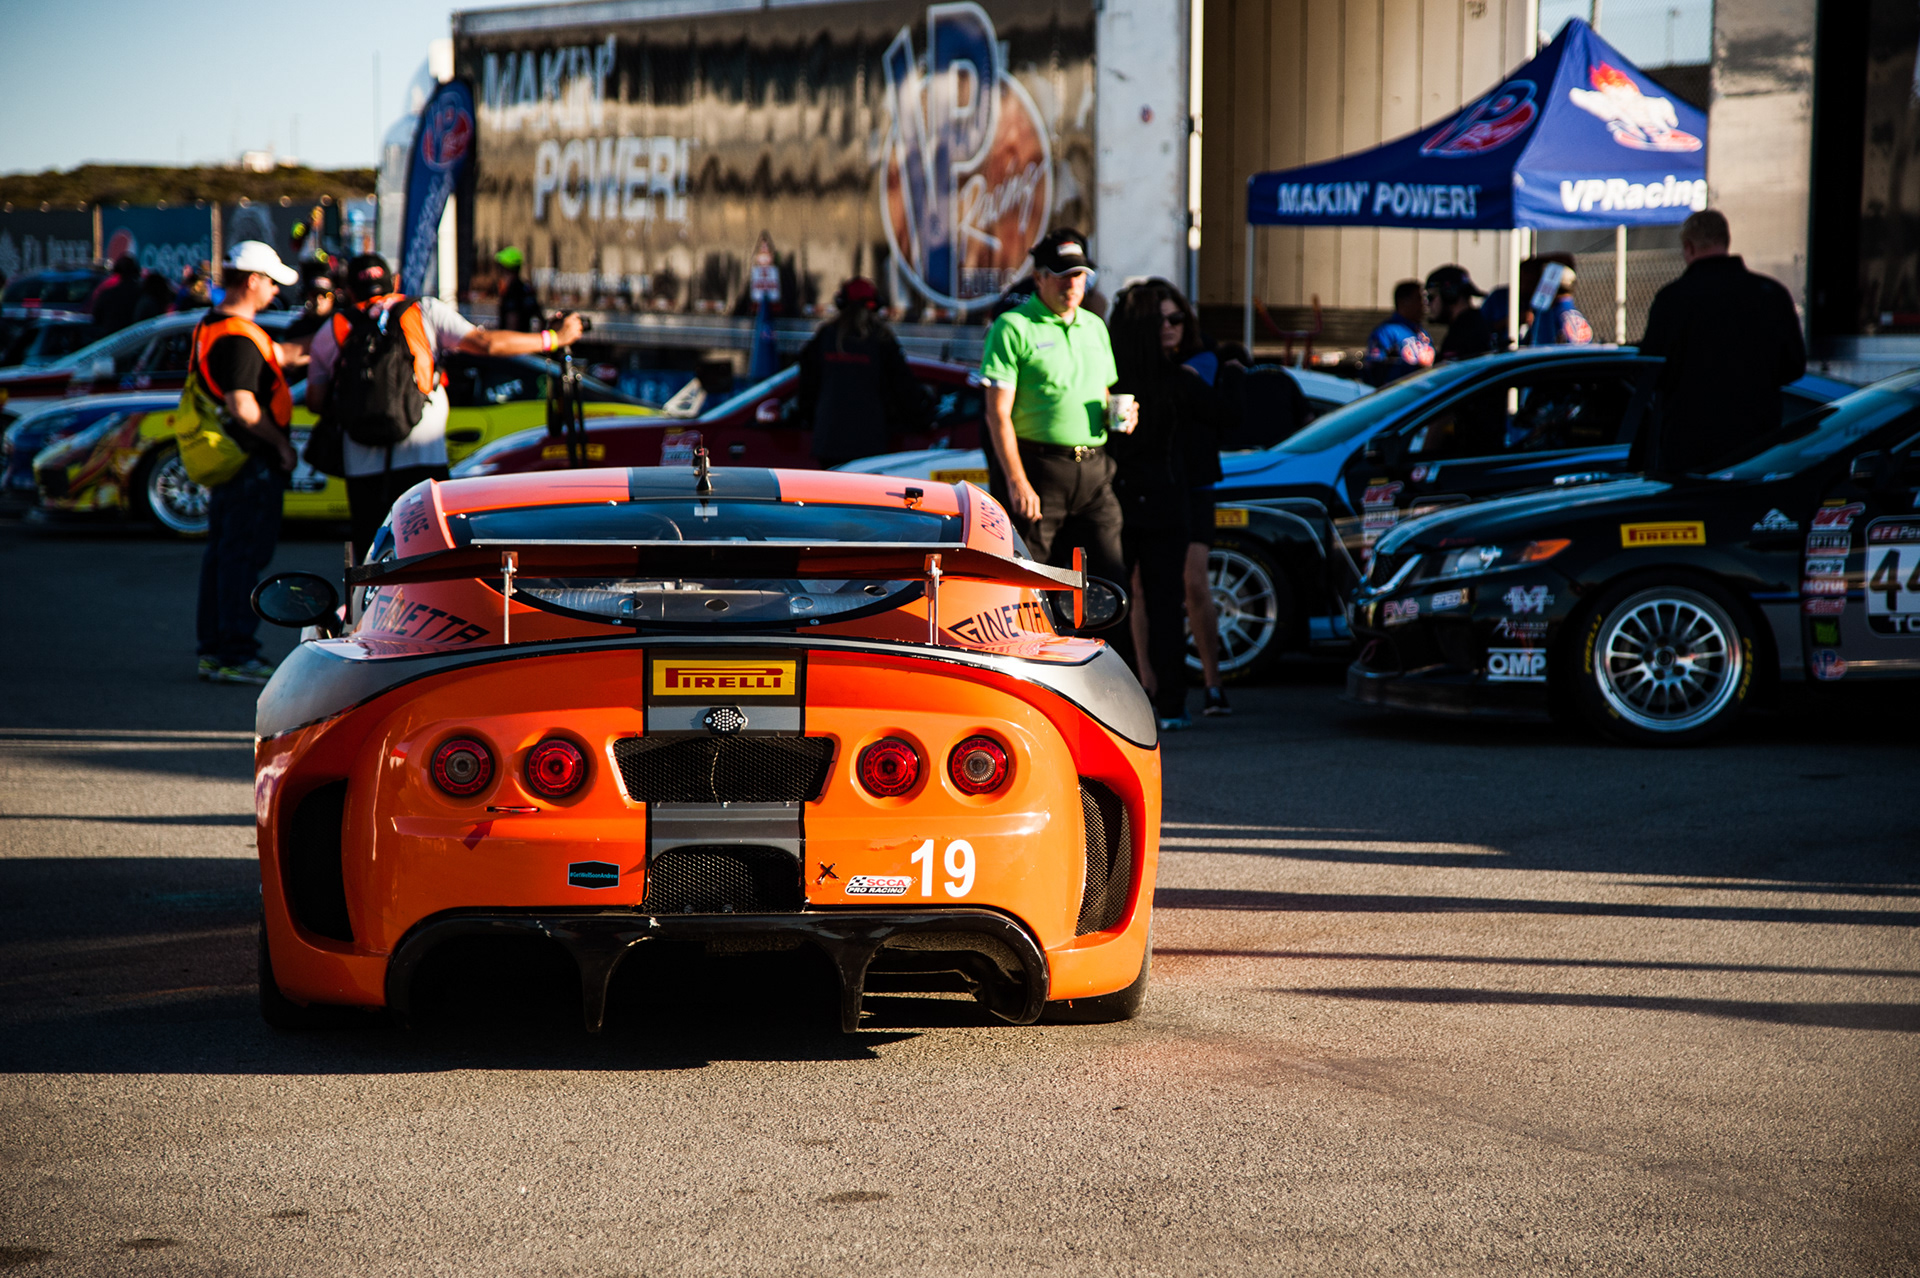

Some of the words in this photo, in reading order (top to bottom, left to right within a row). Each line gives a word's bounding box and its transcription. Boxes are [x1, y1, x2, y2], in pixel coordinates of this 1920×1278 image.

[533, 134, 689, 222] POWER!
[1277, 181, 1369, 217] MAKIN'
[1372, 181, 1478, 219] POWER!
[1628, 526, 1698, 542] PIRELLI
[1810, 536, 1847, 547] OPTIMA
[1802, 581, 1845, 594] MOTUL
[371, 594, 490, 646] GINETTA
[946, 601, 1046, 644] GINETTA
[1488, 653, 1547, 675] OMP
[665, 667, 784, 688] PIRELLI
[911, 838, 976, 897] 19
[866, 878, 906, 887] SCCA
